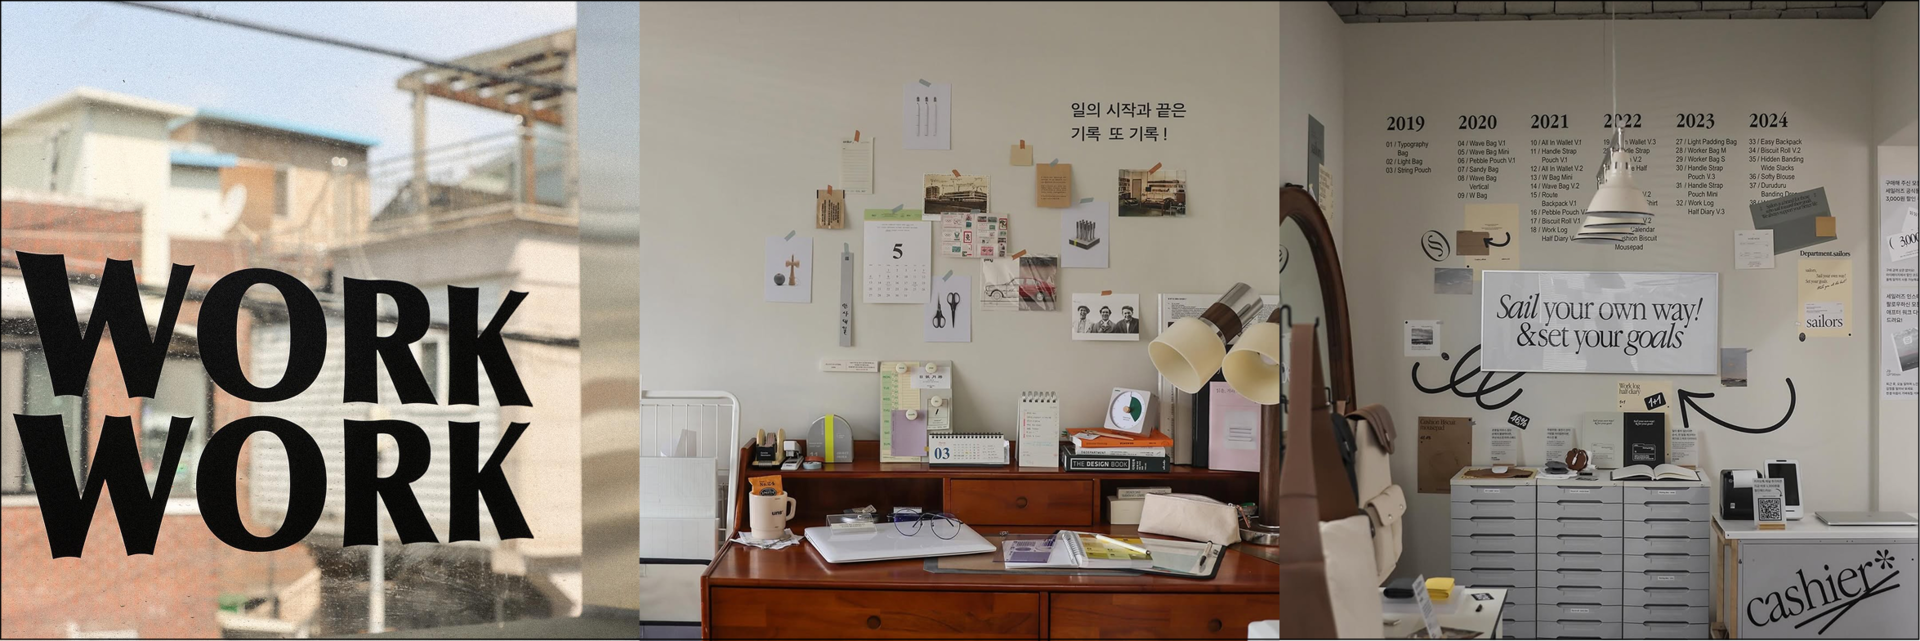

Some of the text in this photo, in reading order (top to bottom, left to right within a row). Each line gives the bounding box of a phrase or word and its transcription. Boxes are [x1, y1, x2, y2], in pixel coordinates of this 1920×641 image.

[1072, 102, 1186, 118] 일의 시작과 끝은
[1387, 116, 1424, 132] 2019
[1459, 115, 1497, 130] 2020
[1531, 114, 1568, 129] 2021
[1677, 113, 1714, 129] 2023
[1750, 112, 1788, 128] 2024
[1072, 126, 1101, 141] 기록
[1109, 128, 1124, 140] 또
[1398, 141, 1428, 149] Typography
[1702, 138, 1724, 146] Padding
[1726, 138, 1737, 146] Bag
[1709, 147, 1720, 155] Bag
[1412, 158, 1423, 166] Bag
[1709, 156, 1720, 164] Bag
[1549, 174, 1560, 182] Bag
[1476, 192, 1487, 200] Bag
[1542, 200, 1568, 208] Backpack
[1554, 235, 1568, 243] Diary
[893, 243, 903, 259] 5
[1497, 293, 1703, 328] Sail your own way!
[1806, 314, 1843, 328] sailors
[15, 251, 532, 407] WORK
[1574, 329, 1623, 354] your
[1624, 322, 1684, 356] goals
[1648, 394, 1662, 407] 1+1
[934, 447, 950, 460] 03
[13, 413, 534, 559] WORK
